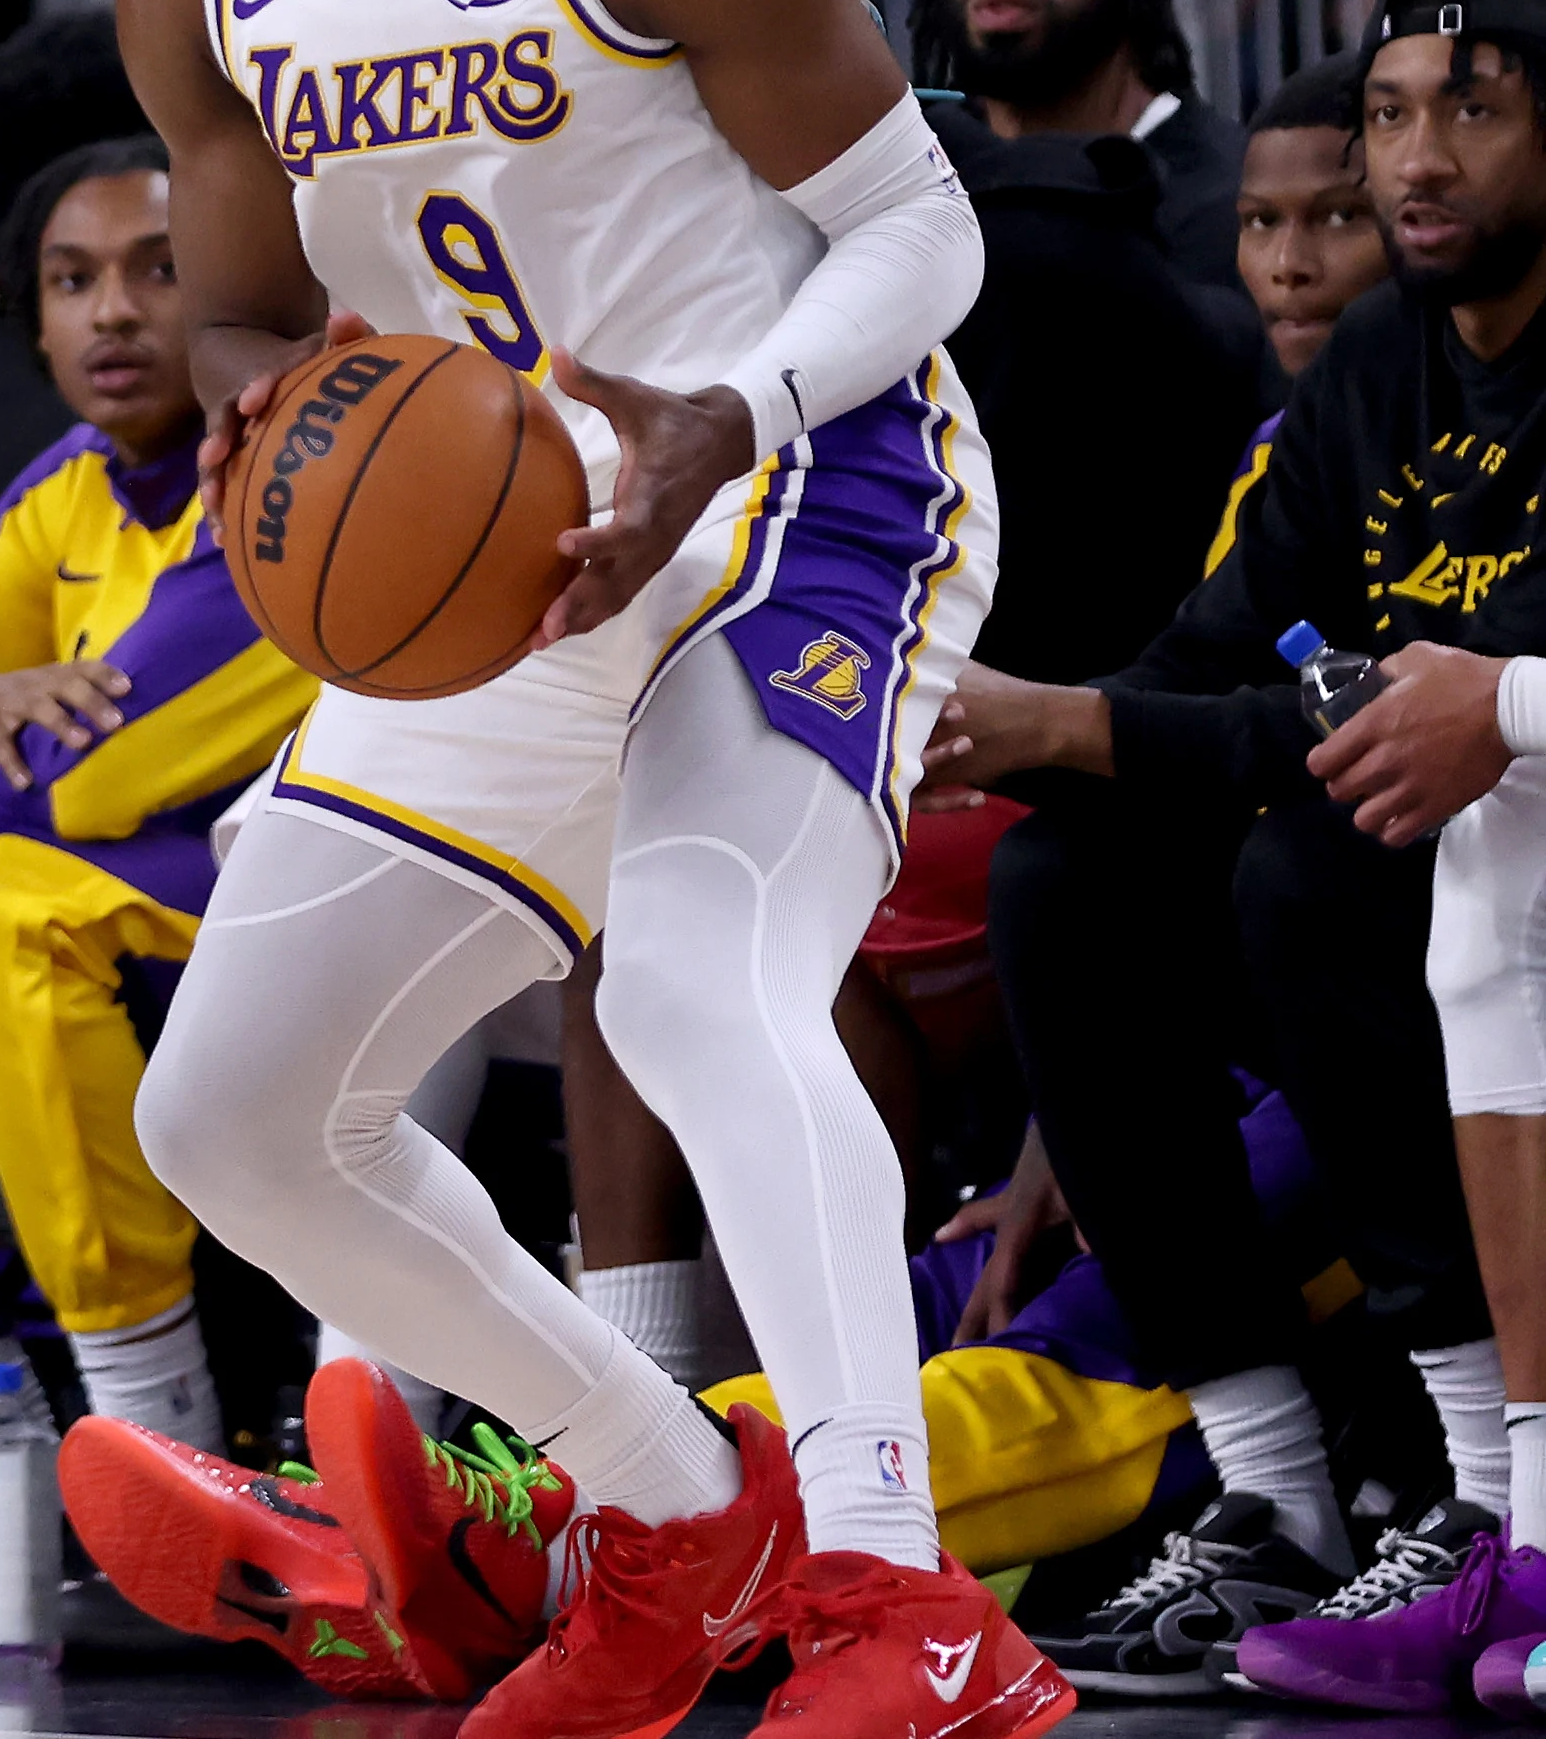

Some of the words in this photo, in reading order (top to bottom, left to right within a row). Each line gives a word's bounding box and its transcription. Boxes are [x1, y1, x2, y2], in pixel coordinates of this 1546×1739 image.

[247, 26, 575, 181] LAKERS
[414, 189, 551, 389] 9
[256, 352, 405, 564] Wilson
